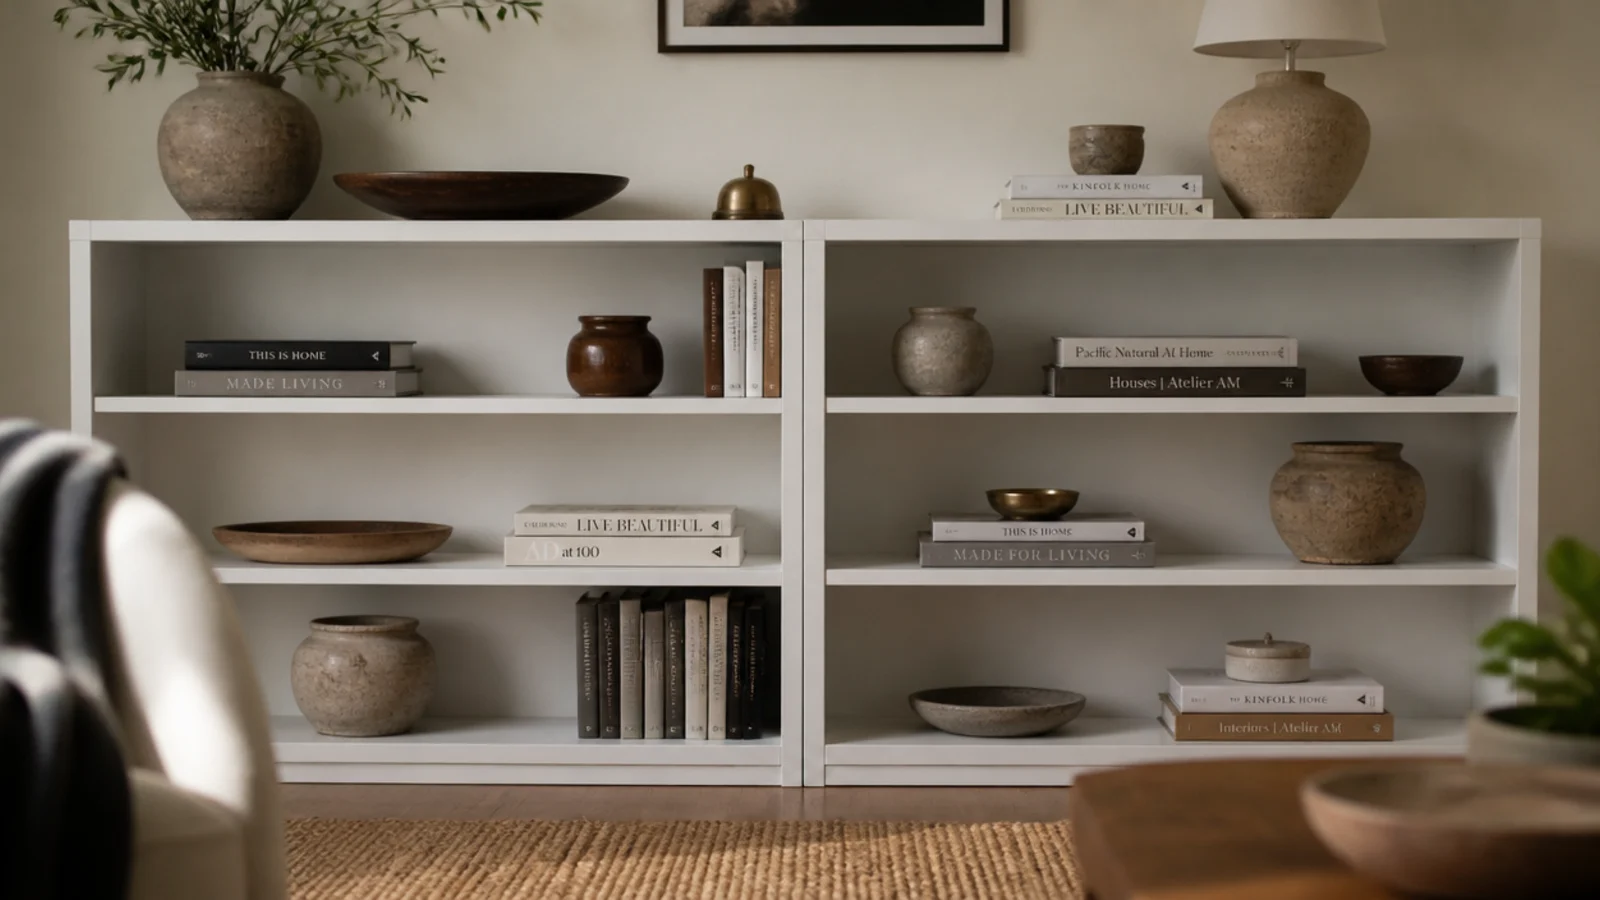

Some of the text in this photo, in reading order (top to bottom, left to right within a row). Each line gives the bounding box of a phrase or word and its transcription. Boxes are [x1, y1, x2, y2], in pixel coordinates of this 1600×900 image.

[1072, 182, 1121, 191] KINFOLK
[1065, 202, 1101, 216] LIVE
[1104, 202, 1189, 216] BEAUTIFUL
[249, 351, 276, 361] THIS
[278, 351, 289, 361] IS
[226, 377, 343, 390] MADE LIVING
[1109, 376, 1157, 389] Houses
[1167, 376, 1214, 389] Atelier
[1216, 376, 1241, 389] AM
[576, 518, 613, 533] LIVE
[616, 518, 703, 533] BEAUTIFUL
[1002, 527, 1026, 537] THIS
[1028, 527, 1039, 537] IS
[524, 540, 600, 561] AD at 100
[953, 548, 1110, 561] MADE FOR LIVING
[1244, 695, 1297, 704] KINFOLK
[1218, 722, 1270, 734] Interiors
